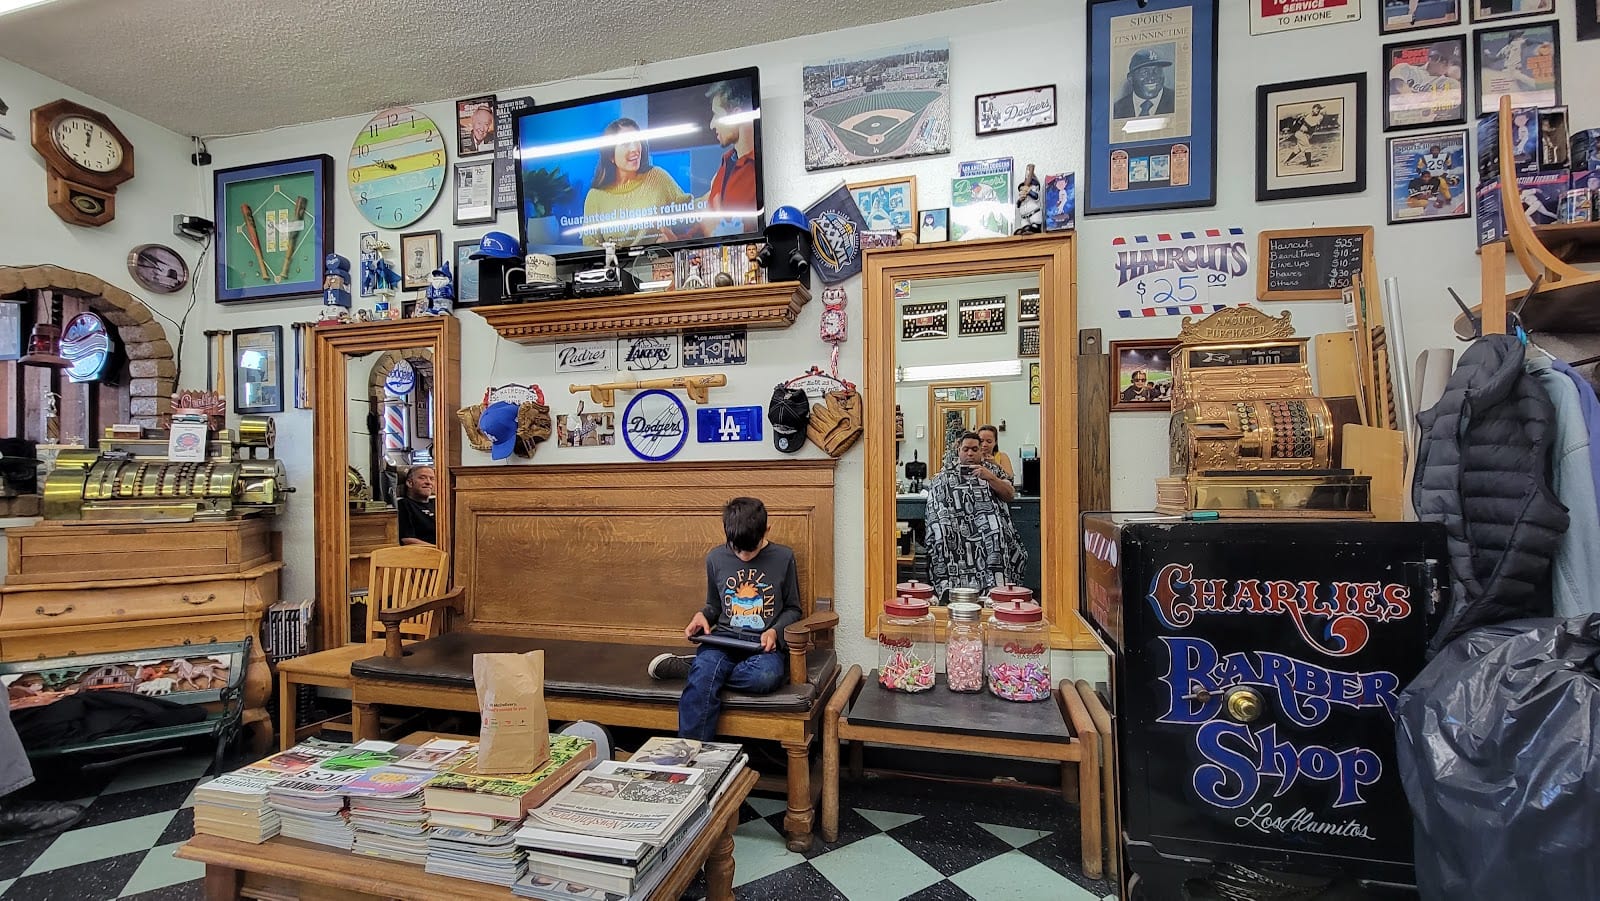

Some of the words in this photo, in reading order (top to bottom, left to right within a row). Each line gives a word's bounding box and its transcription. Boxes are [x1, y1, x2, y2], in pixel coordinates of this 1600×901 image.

[1283, 1, 1325, 13] SERVICE
[1130, 13, 1172, 26] SPORTS
[1278, 17, 1290, 25] TO
[1294, 11, 1332, 23] ANYONE
[1004, 98, 1052, 122] Dodgers
[386, 113, 399, 127] 12
[411, 115, 415, 128] 1
[369, 125, 378, 138] 11
[425, 129, 433, 142] 2
[358, 144, 369, 158] 10
[432, 152, 441, 167] 3
[352, 169, 360, 183] 9
[427, 177, 436, 190] 4
[360, 191, 368, 206] 8
[414, 198, 423, 212] 5
[375, 206, 382, 220] 7
[394, 208, 403, 222] 6
[619, 205, 658, 221] biggest
[660, 201, 695, 215] refund
[697, 201, 708, 210] or
[631, 217, 655, 230] back
[656, 215, 677, 231] plus
[1270, 239, 1313, 250] Haircuts
[1300, 249, 1320, 258] Trims
[1115, 241, 1248, 288] HAIRCUTS
[1205, 325, 1266, 338] PURCHASED
[624, 344, 671, 362] LAKERS
[722, 339, 746, 358] FAN
[559, 345, 607, 368] Padres
[628, 416, 682, 442] Dodgers
[718, 408, 741, 442] LA
[726, 568, 775, 619] OFFLINE
[1156, 636, 1400, 727] BARBER
[1235, 803, 1285, 834] Los
[1280, 807, 1376, 840] Alamitos
